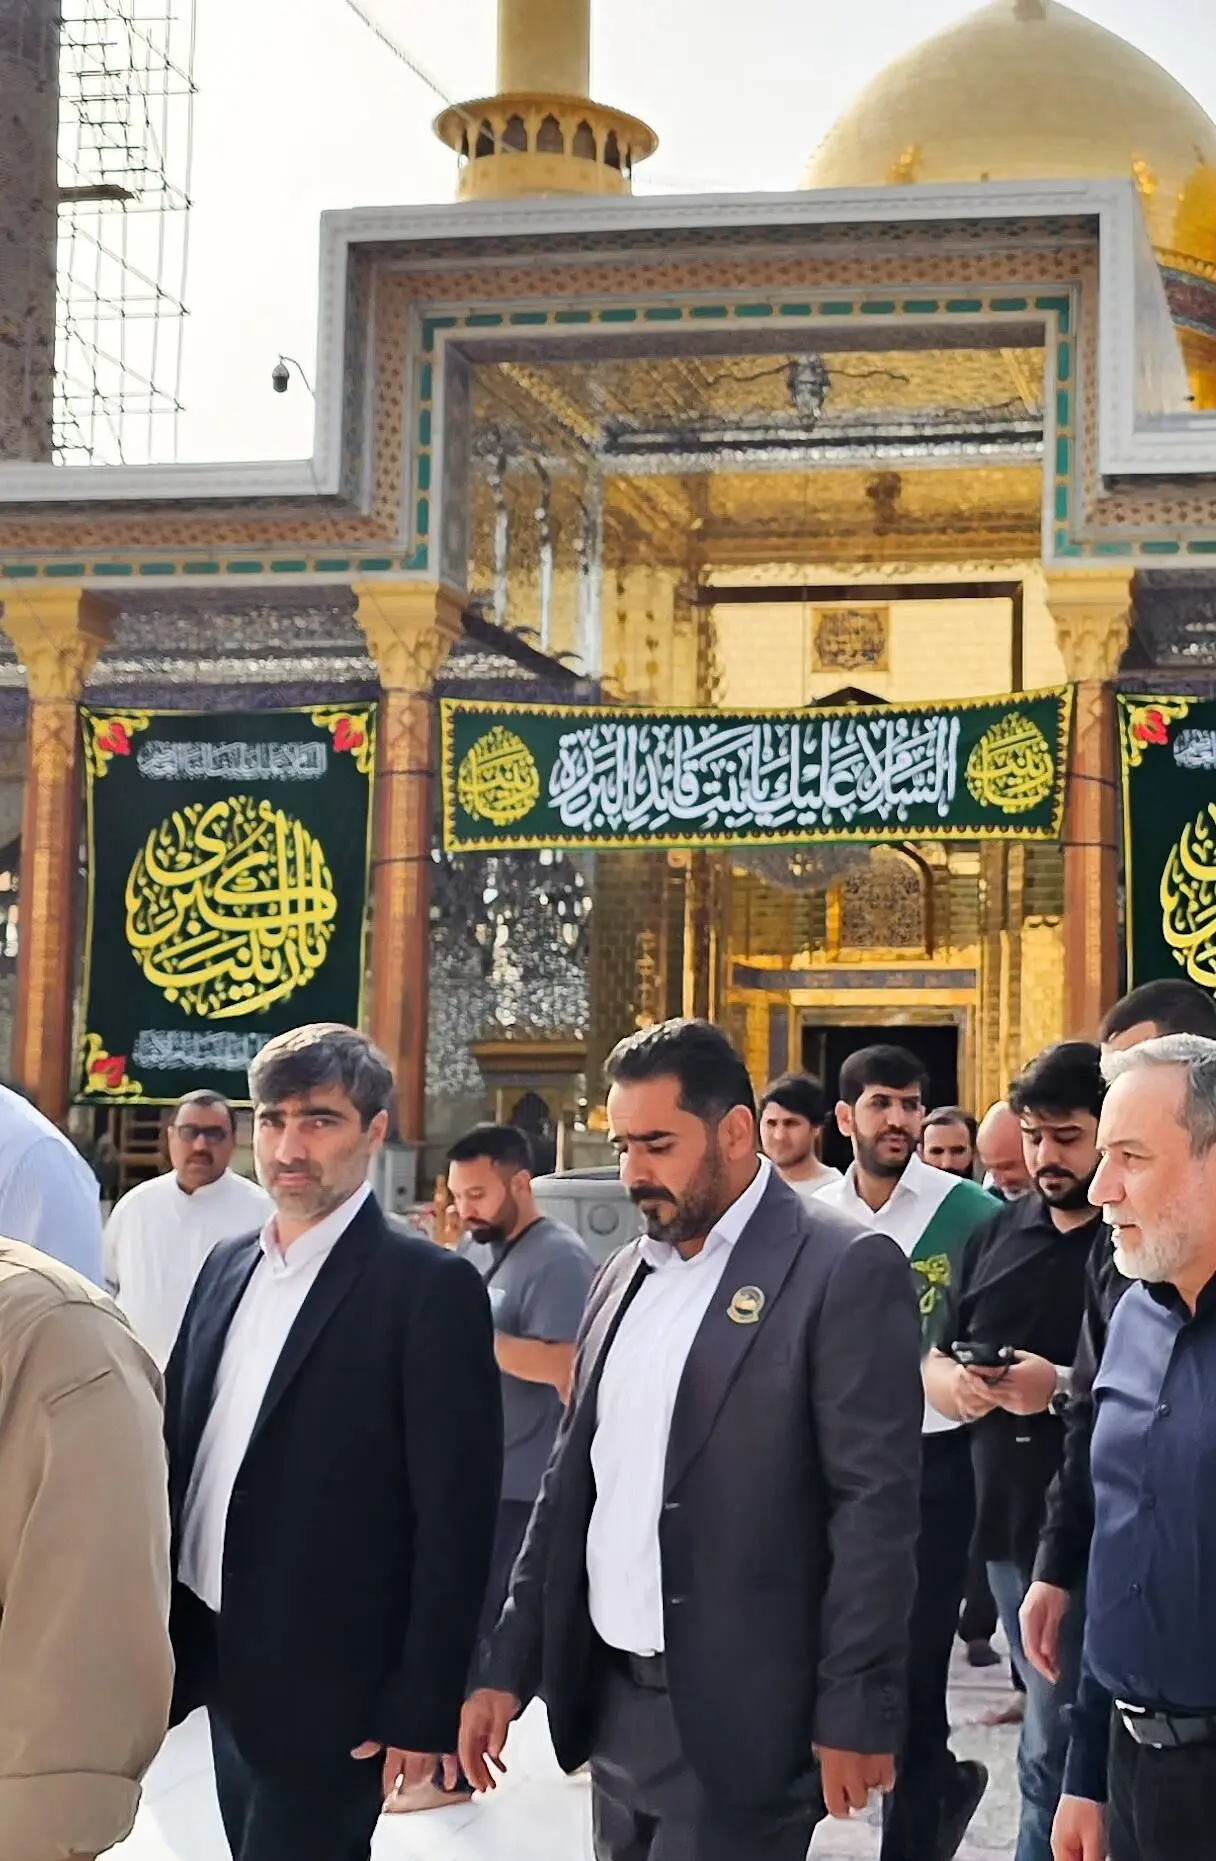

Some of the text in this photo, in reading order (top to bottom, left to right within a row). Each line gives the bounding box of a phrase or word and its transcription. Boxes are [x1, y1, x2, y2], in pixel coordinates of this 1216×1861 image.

[748, 720, 857, 826] عليك
[856, 716, 960, 816] السلام
[125, 799, 338, 949] الكبرى
[142, 928, 300, 1019] زينب
